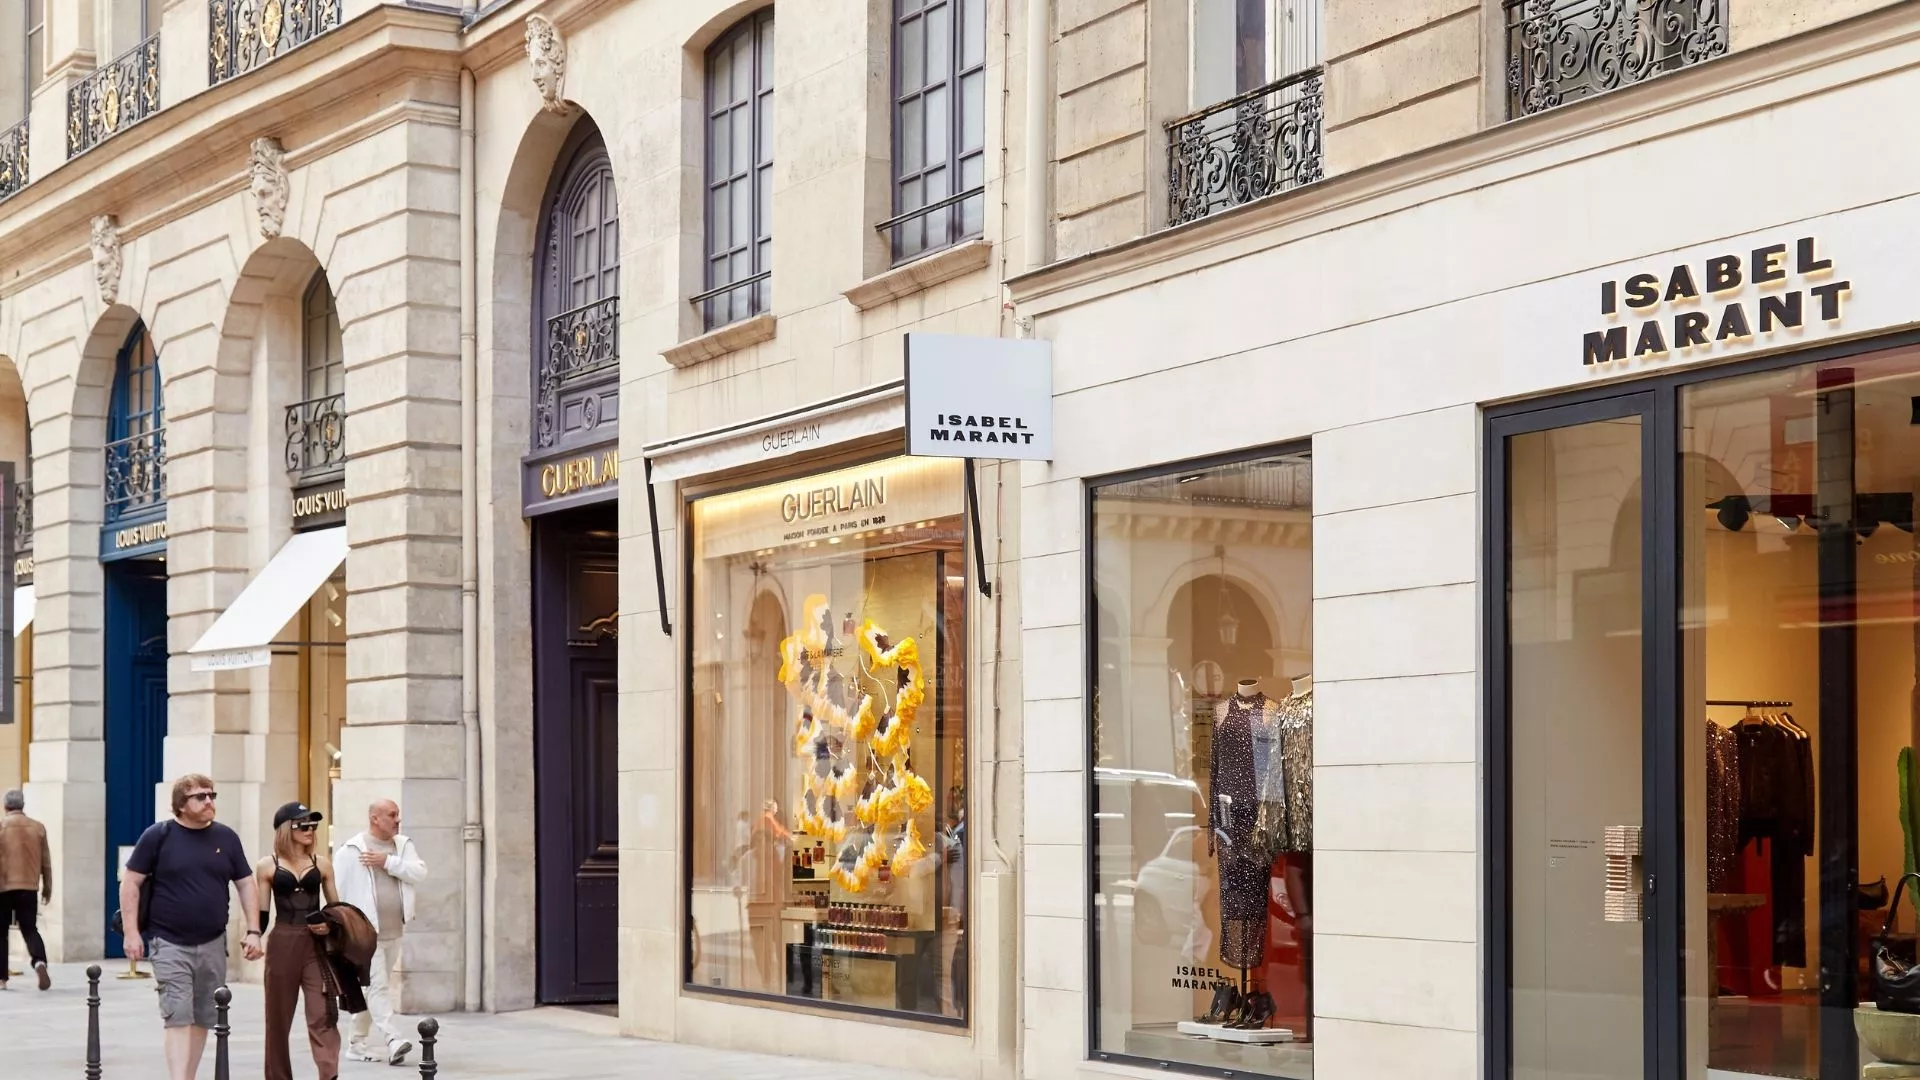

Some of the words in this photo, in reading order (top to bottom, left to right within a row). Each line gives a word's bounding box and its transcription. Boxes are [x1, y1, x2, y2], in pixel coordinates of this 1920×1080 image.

[1601, 237, 1832, 315] ISABEL
[1583, 280, 1850, 366] MARANT
[938, 414, 1028, 429] ISABEL
[762, 423, 821, 452] GUERLAIN
[930, 429, 1034, 444] MARANT
[292, 493, 321, 517] LOUIS
[781, 476, 884, 523] GUERLAIN
[840, 521, 858, 530] PARIS
[116, 527, 139, 548] LOUIS
[1176, 965, 1222, 979] ISABEL
